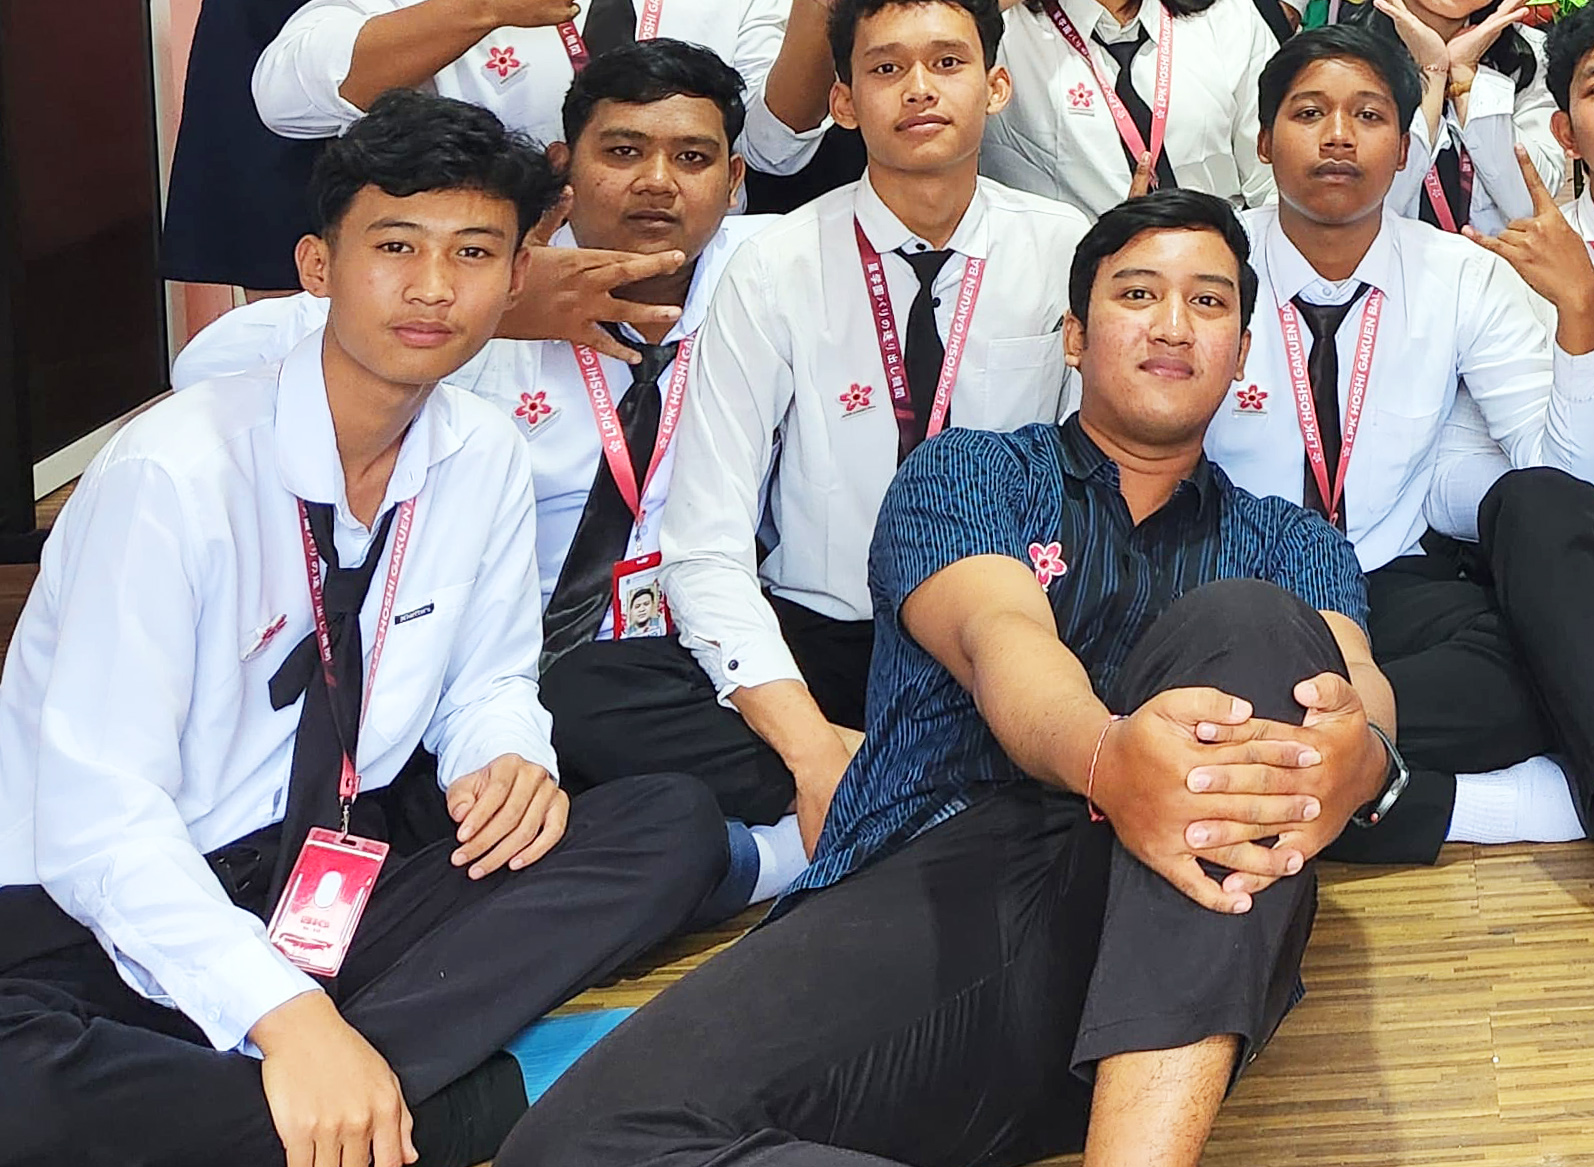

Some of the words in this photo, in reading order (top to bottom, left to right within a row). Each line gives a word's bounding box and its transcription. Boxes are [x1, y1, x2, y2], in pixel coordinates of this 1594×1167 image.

[1158, 55, 1170, 86] HOSHI
[1157, 86, 1168, 108] LPK
[954, 280, 976, 333] GAKUEN
[943, 335, 962, 378] HOSHI
[1285, 323, 1305, 379] GAKUEN
[1357, 316, 1377, 373] GAKUEN
[586, 367, 608, 409] HOSHI
[670, 360, 688, 405] HOSHI
[936, 377, 952, 405] LPK
[1294, 381, 1314, 424] HOSHI
[1350, 373, 1368, 417] HOSHI
[600, 409, 618, 438] LPK
[662, 404, 679, 435] LPK
[1305, 424, 1320, 450] LPK
[1346, 417, 1358, 443] LPK
[377, 579, 395, 634] HOSHI
[391, 509, 412, 576] GAKUEN
